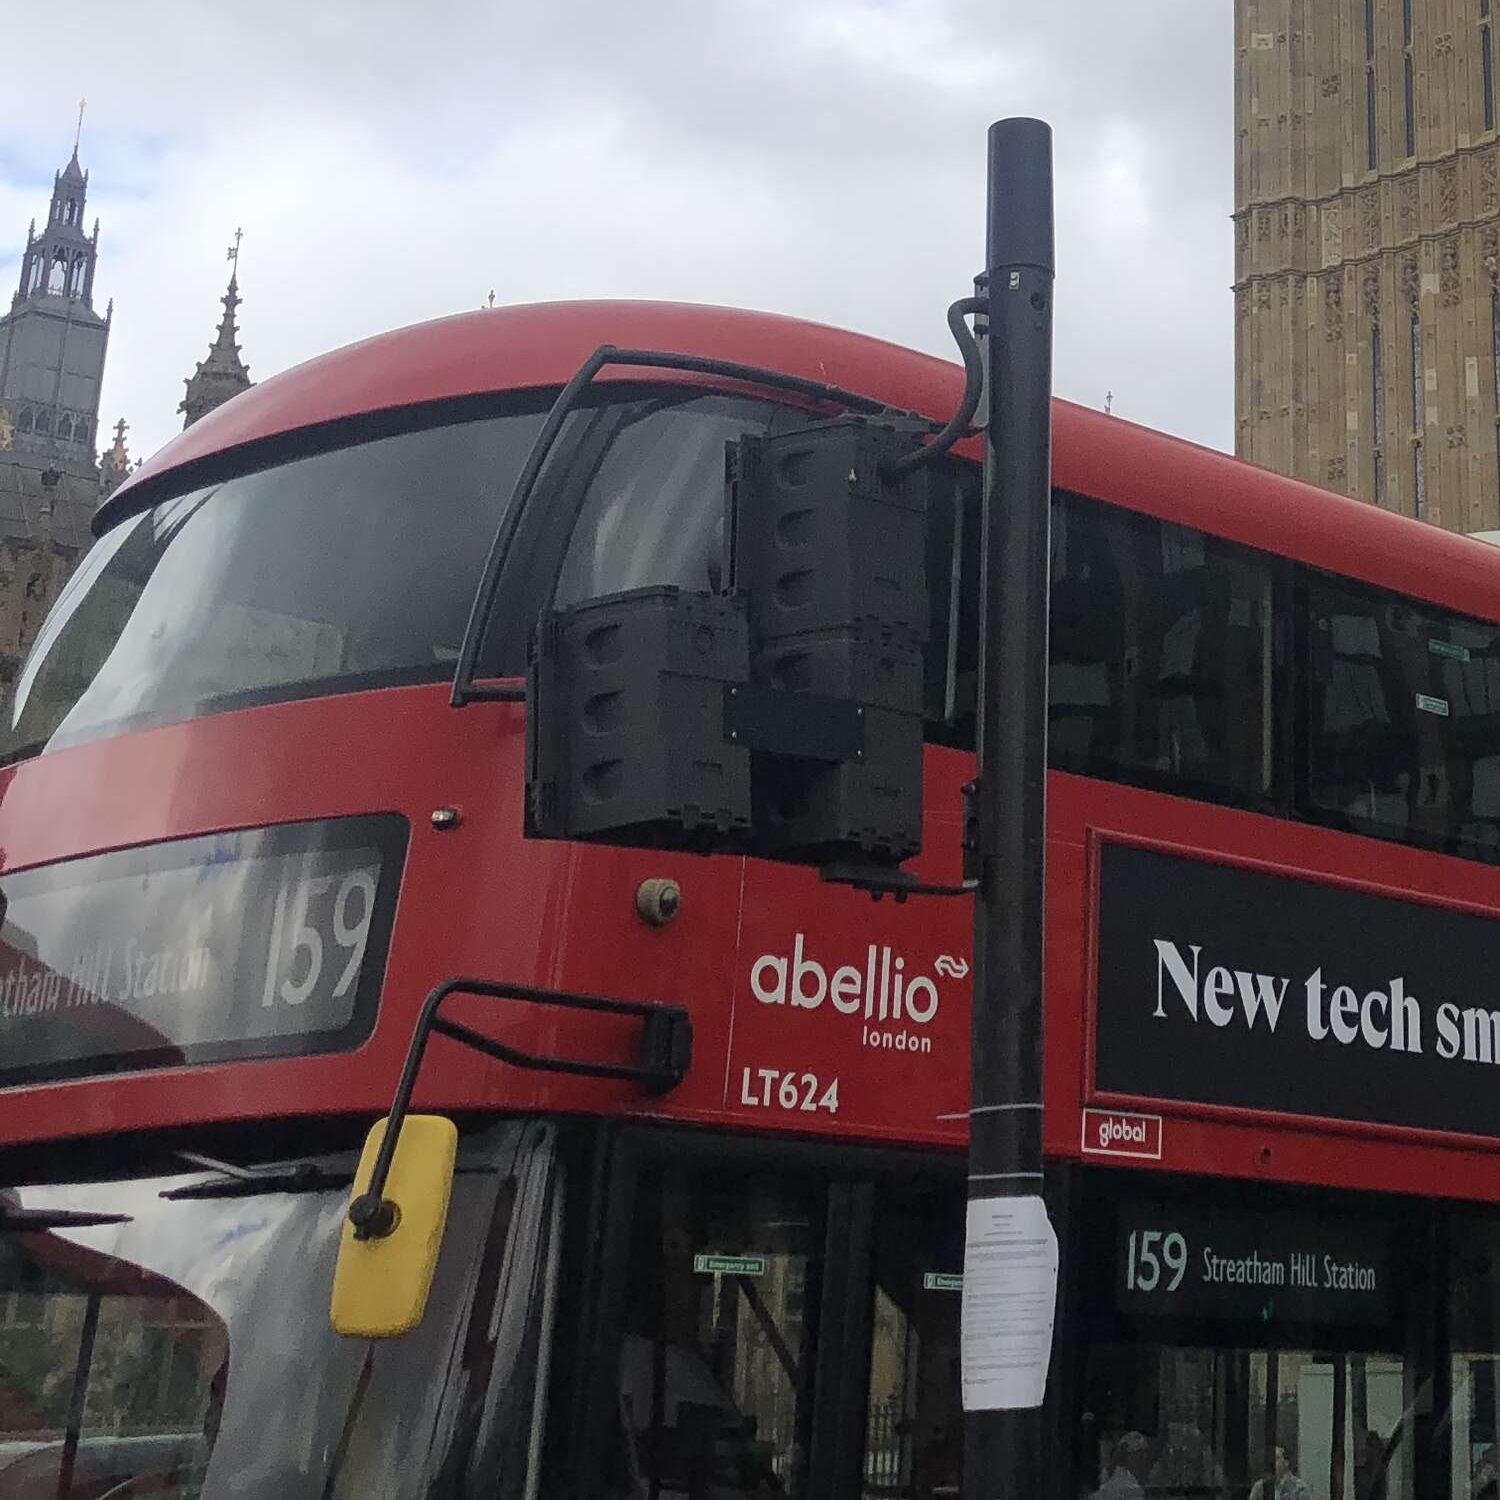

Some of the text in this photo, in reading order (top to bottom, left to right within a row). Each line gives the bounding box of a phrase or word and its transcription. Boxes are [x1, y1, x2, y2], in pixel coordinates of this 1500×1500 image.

[262, 870, 381, 1008] 159
[750, 932, 939, 1023] abellio
[1152, 939, 1290, 1033] New
[1304, 967, 1423, 1054] tech
[862, 1026, 932, 1053] london
[741, 1067, 840, 1113] LT624
[1099, 1117, 1146, 1148] global
[1127, 1230, 1376, 1292] 159 Streatham Hill Station
